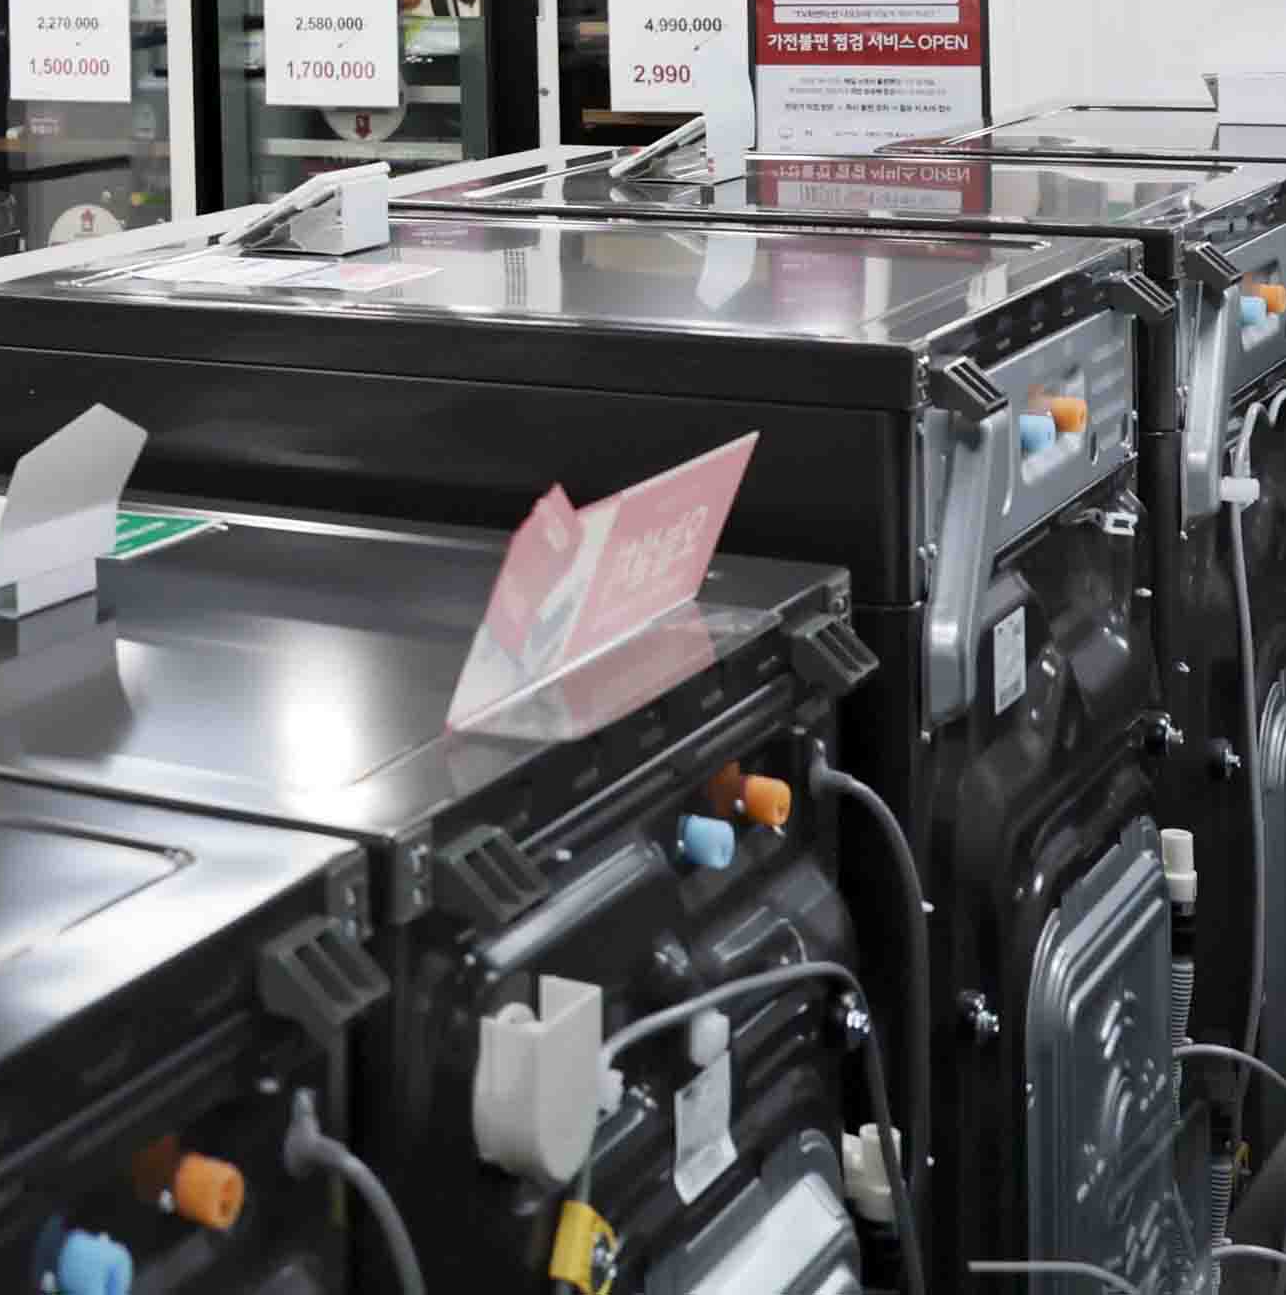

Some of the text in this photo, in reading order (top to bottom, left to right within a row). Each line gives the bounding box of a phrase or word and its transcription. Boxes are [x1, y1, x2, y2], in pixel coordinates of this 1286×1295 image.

[295, 16, 364, 32] 2,580,000
[644, 17, 723, 34] 4,990,000
[832, 32, 864, 51] 점검
[867, 32, 916, 52] 서비스
[917, 34, 968, 50] OPEN
[286, 60, 376, 81] 1,700,000
